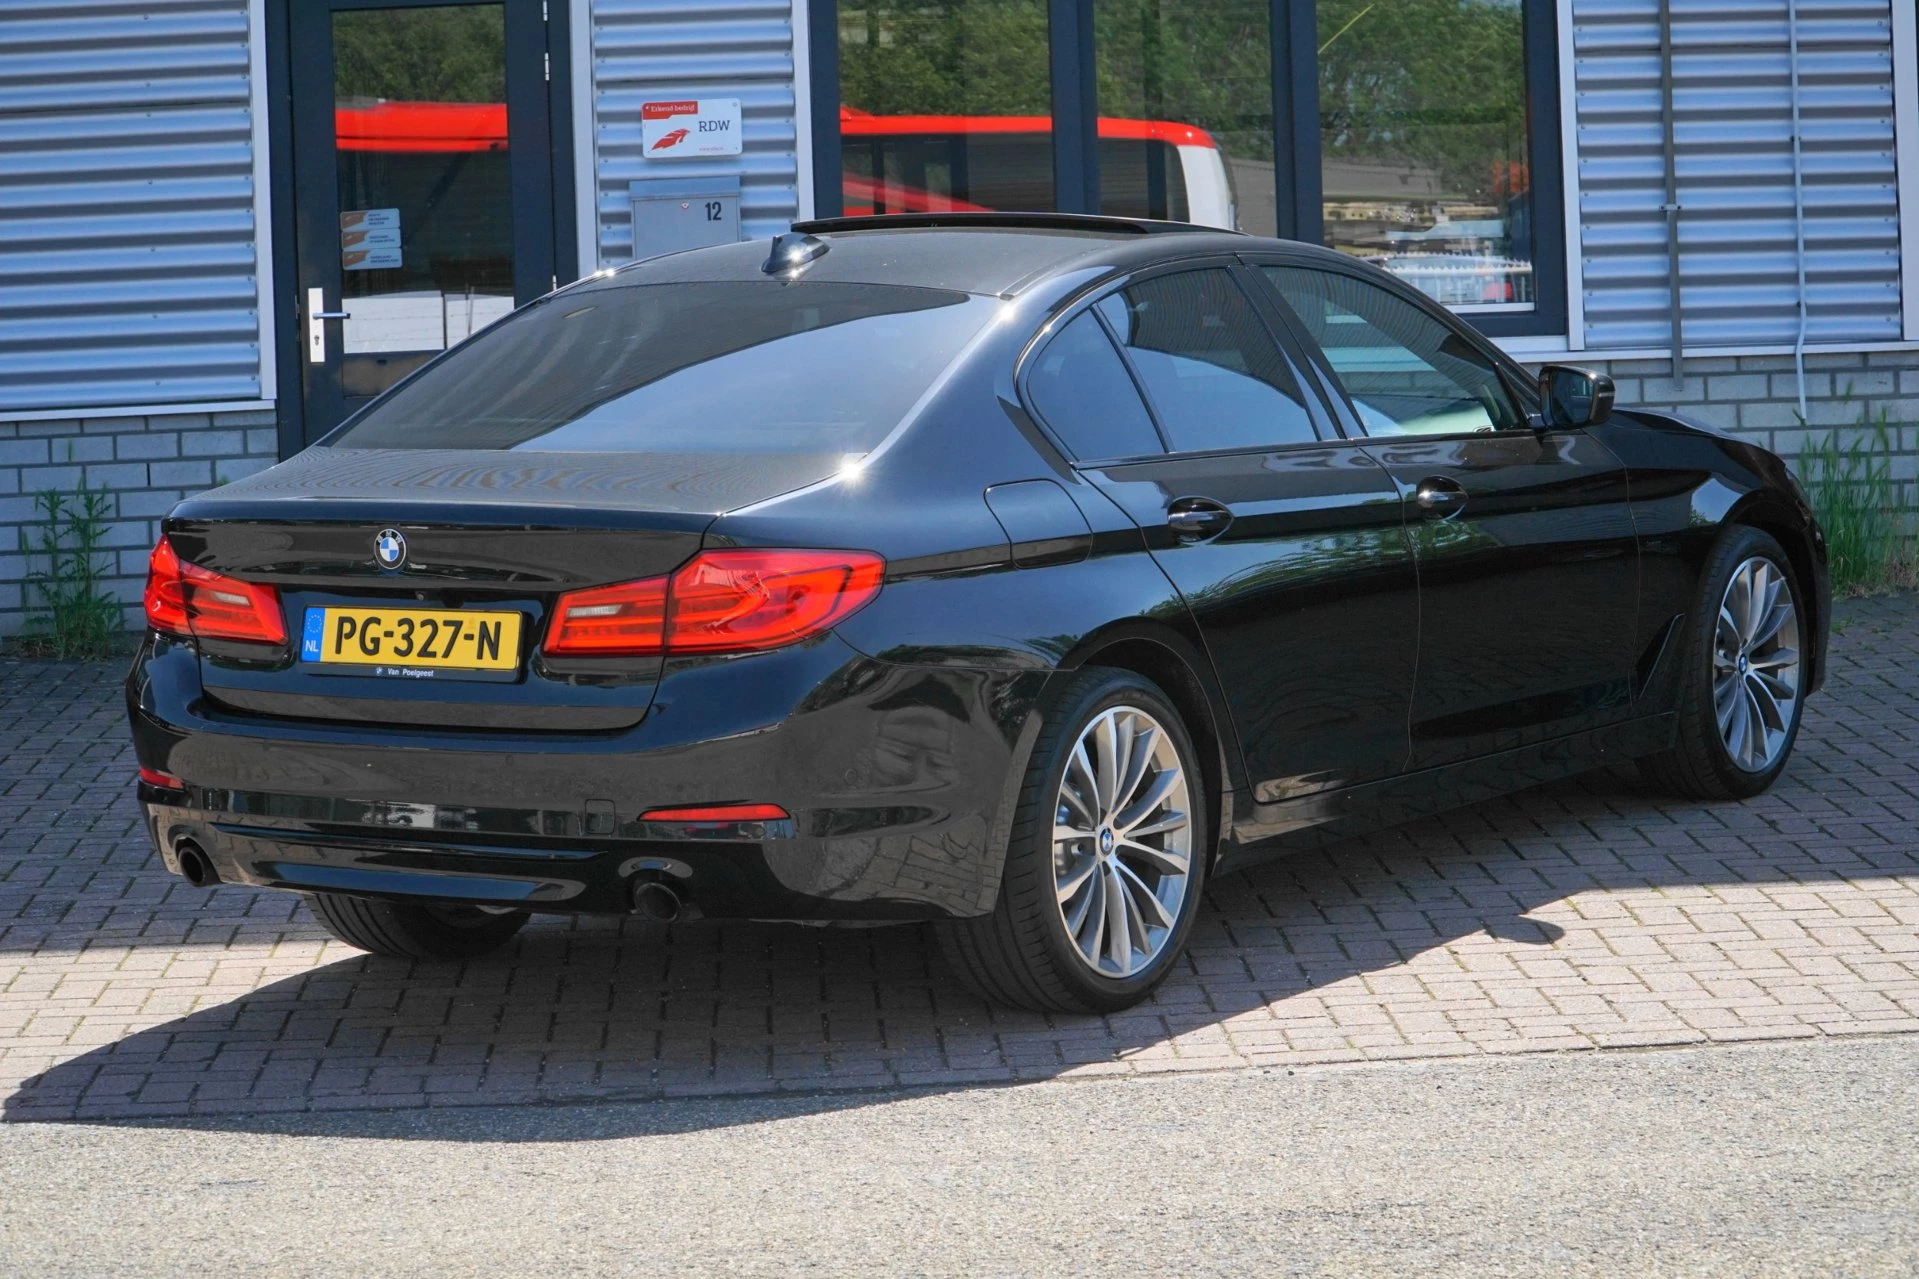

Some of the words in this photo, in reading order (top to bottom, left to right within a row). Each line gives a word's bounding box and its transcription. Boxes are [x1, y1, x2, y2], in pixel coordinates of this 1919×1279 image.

[651, 105, 674, 113] Erkend
[674, 104, 695, 113] bedrijf
[698, 120, 730, 132] RDW
[705, 202, 722, 221] 12
[335, 616, 501, 660] PG-327-N
[305, 640, 319, 653] NL
[387, 668, 400, 676] Van
[402, 668, 434, 678] Poelgeest
